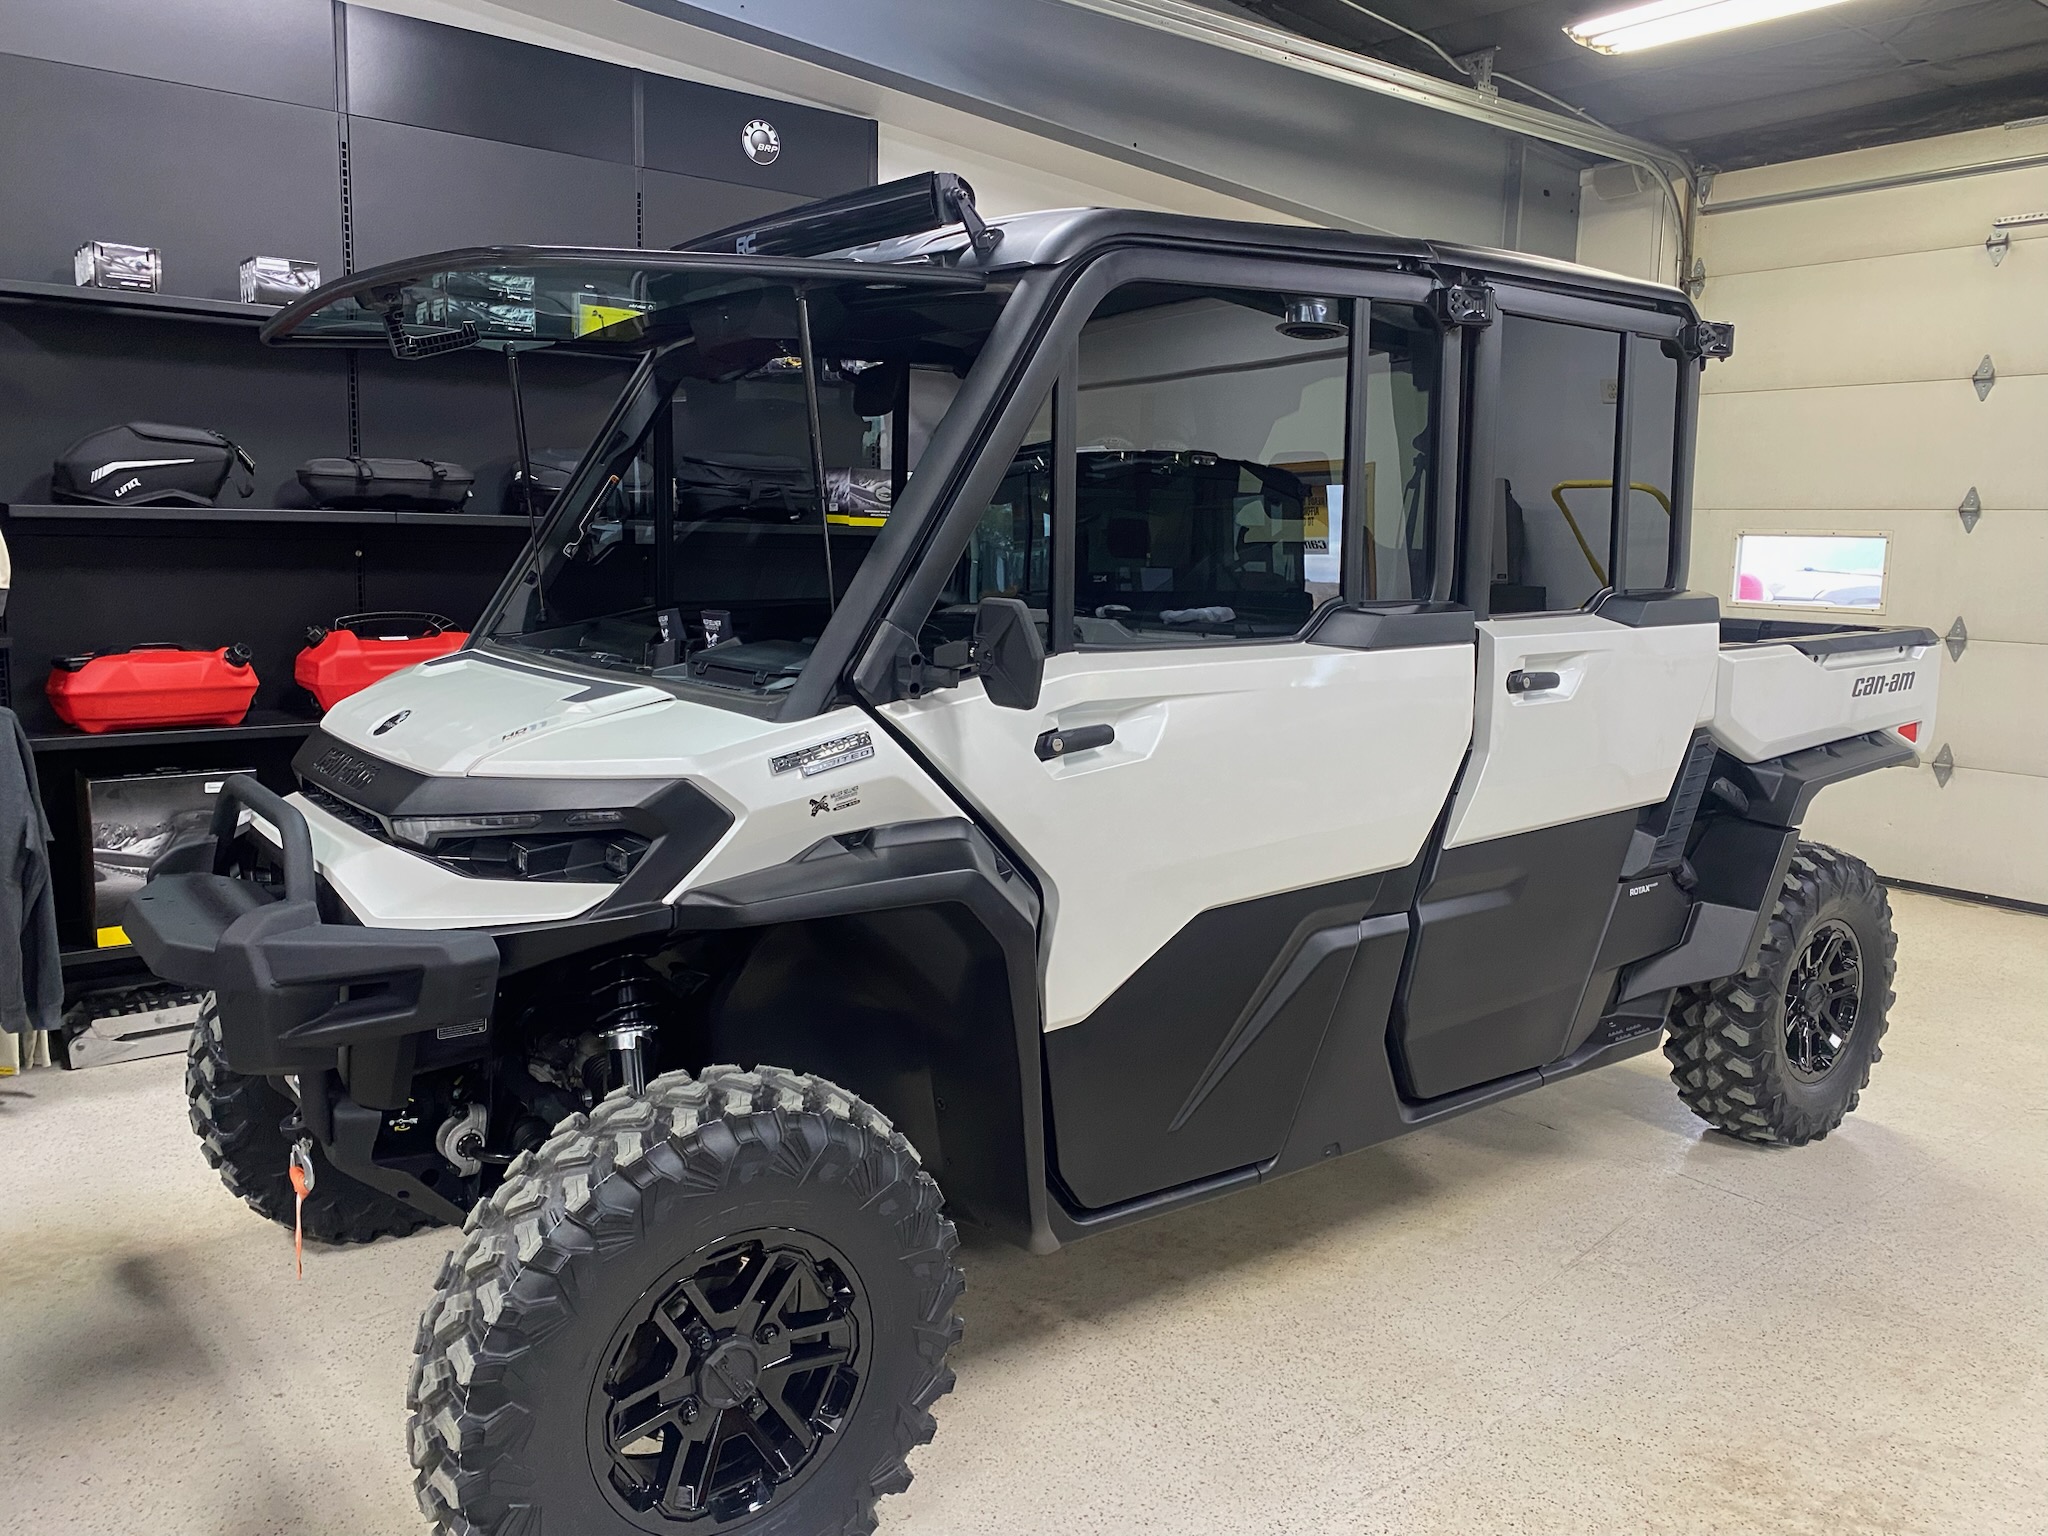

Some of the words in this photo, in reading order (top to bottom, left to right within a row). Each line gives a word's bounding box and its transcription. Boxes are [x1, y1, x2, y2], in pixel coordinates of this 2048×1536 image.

[757, 143, 778, 153] BRP
[736, 233, 756, 254] RC
[1851, 671, 1915, 697] can-am
[772, 731, 872, 773] DEFENDER
[807, 749, 870, 773] LIMITED
[1630, 884, 1650, 896] ROTAX
